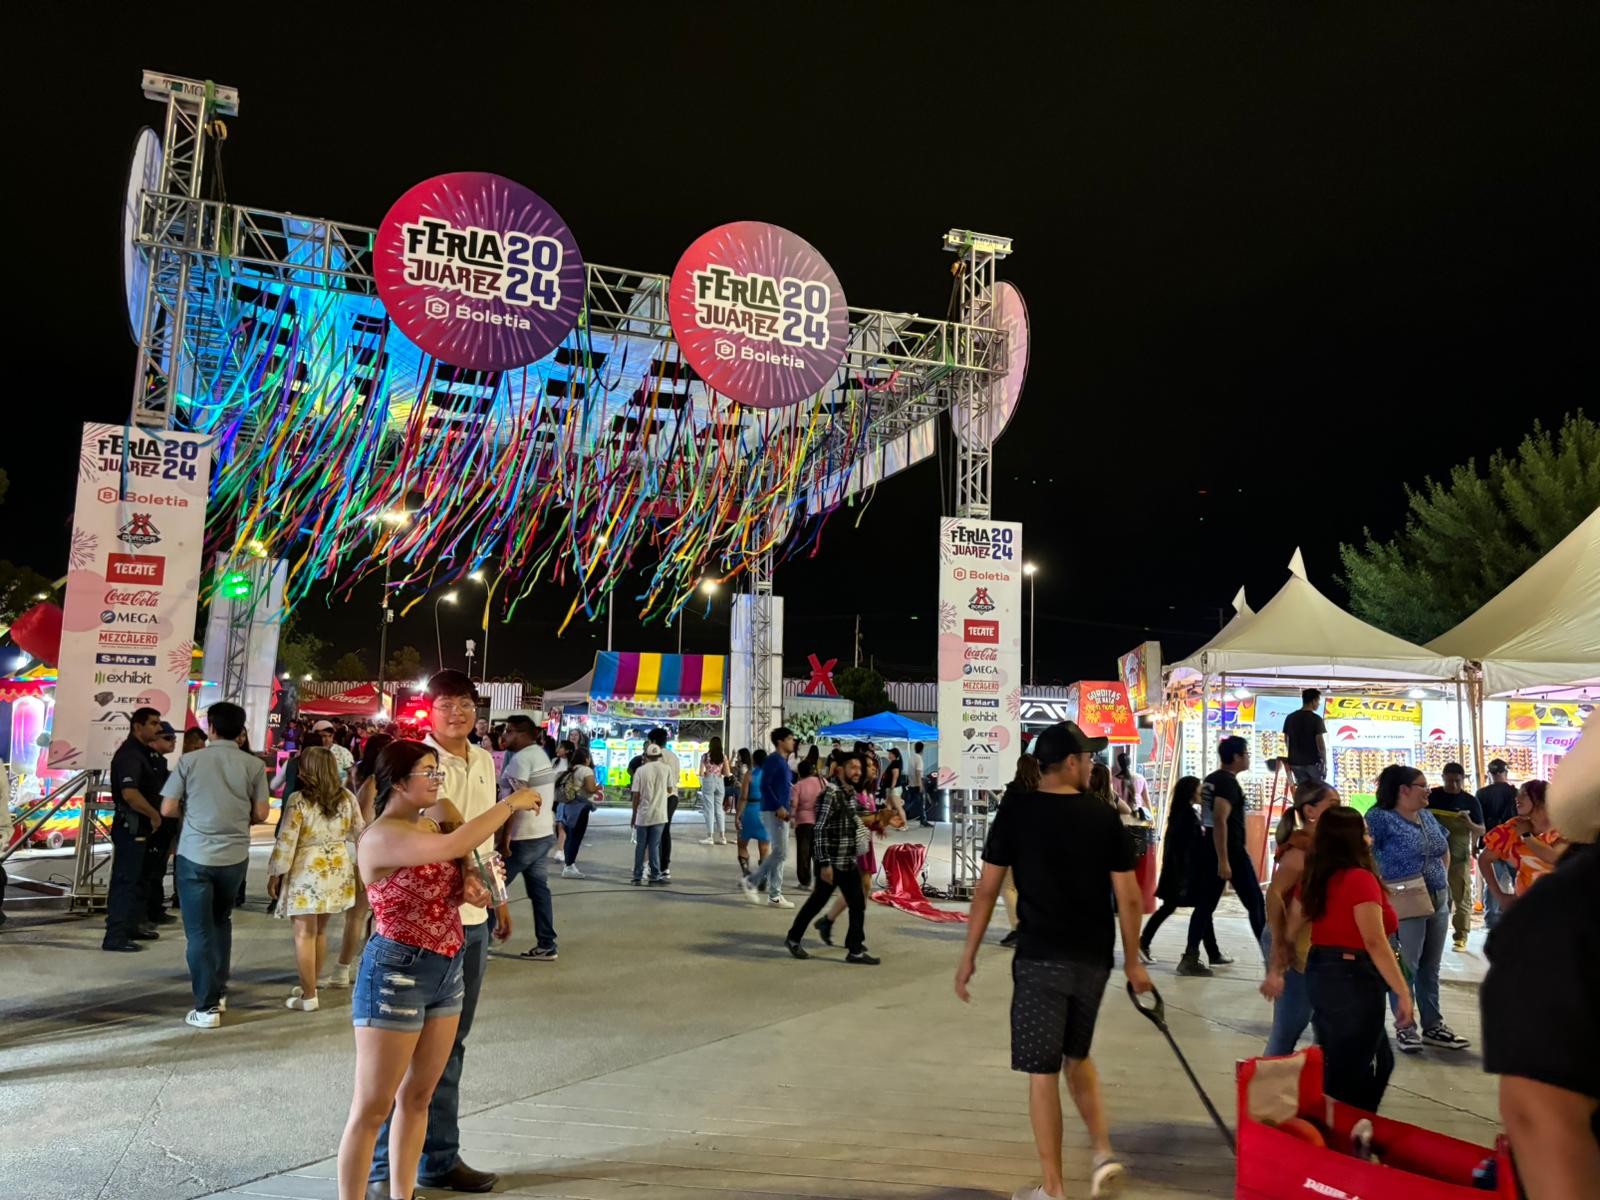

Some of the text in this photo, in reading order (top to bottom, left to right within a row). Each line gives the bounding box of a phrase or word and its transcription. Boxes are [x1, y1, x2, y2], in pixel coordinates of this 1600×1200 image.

[407, 220, 558, 271] FERIA 20
[407, 258, 556, 305] JUÁREZ 24
[697, 268, 826, 314] FERIA 20
[456, 304, 531, 330] Boletia
[698, 304, 825, 345] JUÁREZ 24
[741, 347, 804, 369] Boletia
[98, 434, 198, 461] FERIA 20
[162, 459, 196, 481] 24
[124, 491, 188, 507] Boletia
[951, 526, 1012, 545] FERIA 20
[992, 543, 1013, 560] 24
[113, 562, 158, 576] TECATE
[970, 570, 1009, 581] Boletia
[117, 612, 158, 624] MEGA
[99, 632, 158, 645] MEZCALERO
[968, 626, 995, 636] TECATE
[107, 670, 152, 685] exhibit
[973, 665, 998, 674] MEGA
[970, 711, 998, 722] exhibit
